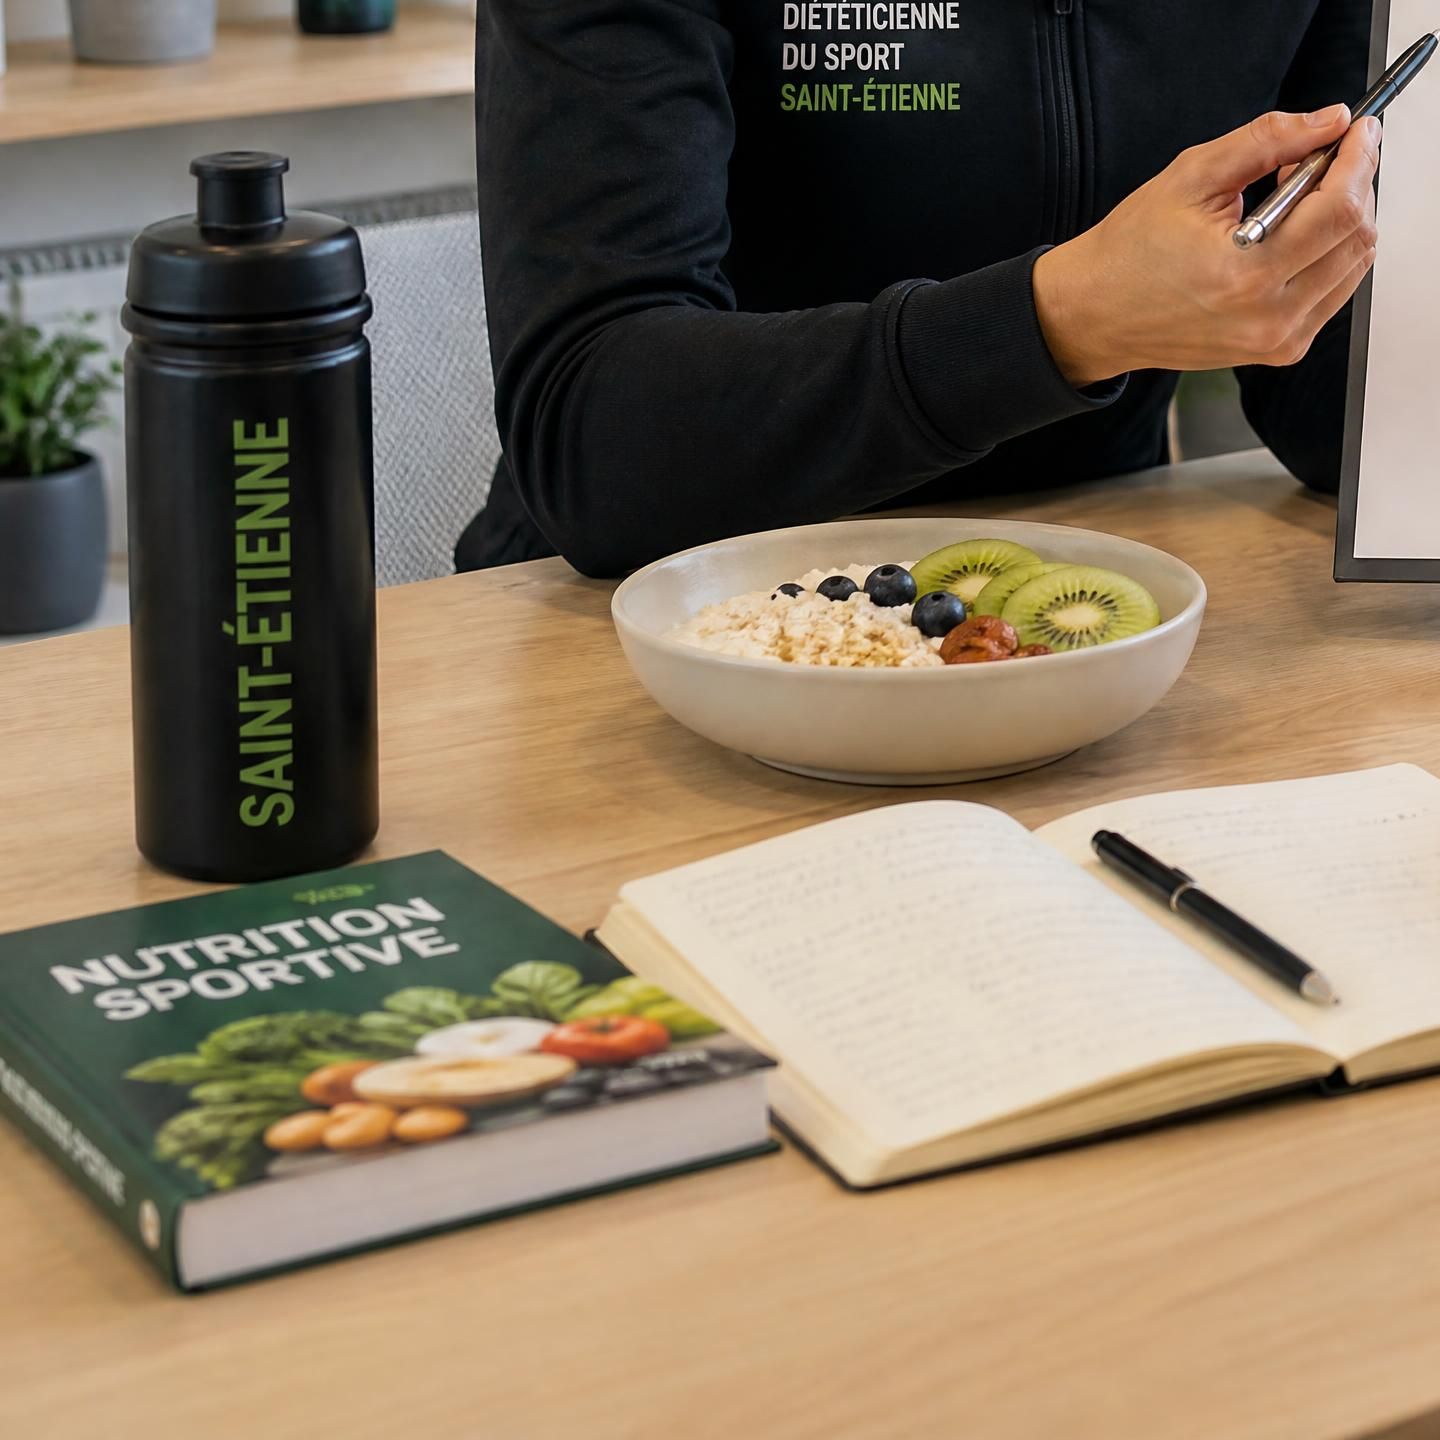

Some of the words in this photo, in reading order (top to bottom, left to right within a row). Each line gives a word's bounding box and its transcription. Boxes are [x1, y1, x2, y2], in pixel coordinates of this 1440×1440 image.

[780, 77, 961, 112] SAINT-ÉTIENNE
[782, 43, 817, 71] DU
[824, 42, 905, 71] SPORT
[222, 416, 295, 828] SAINT-ÉTIENNE
[49, 896, 446, 995] NUTRITION
[92, 926, 461, 1022] SPORTIVE
